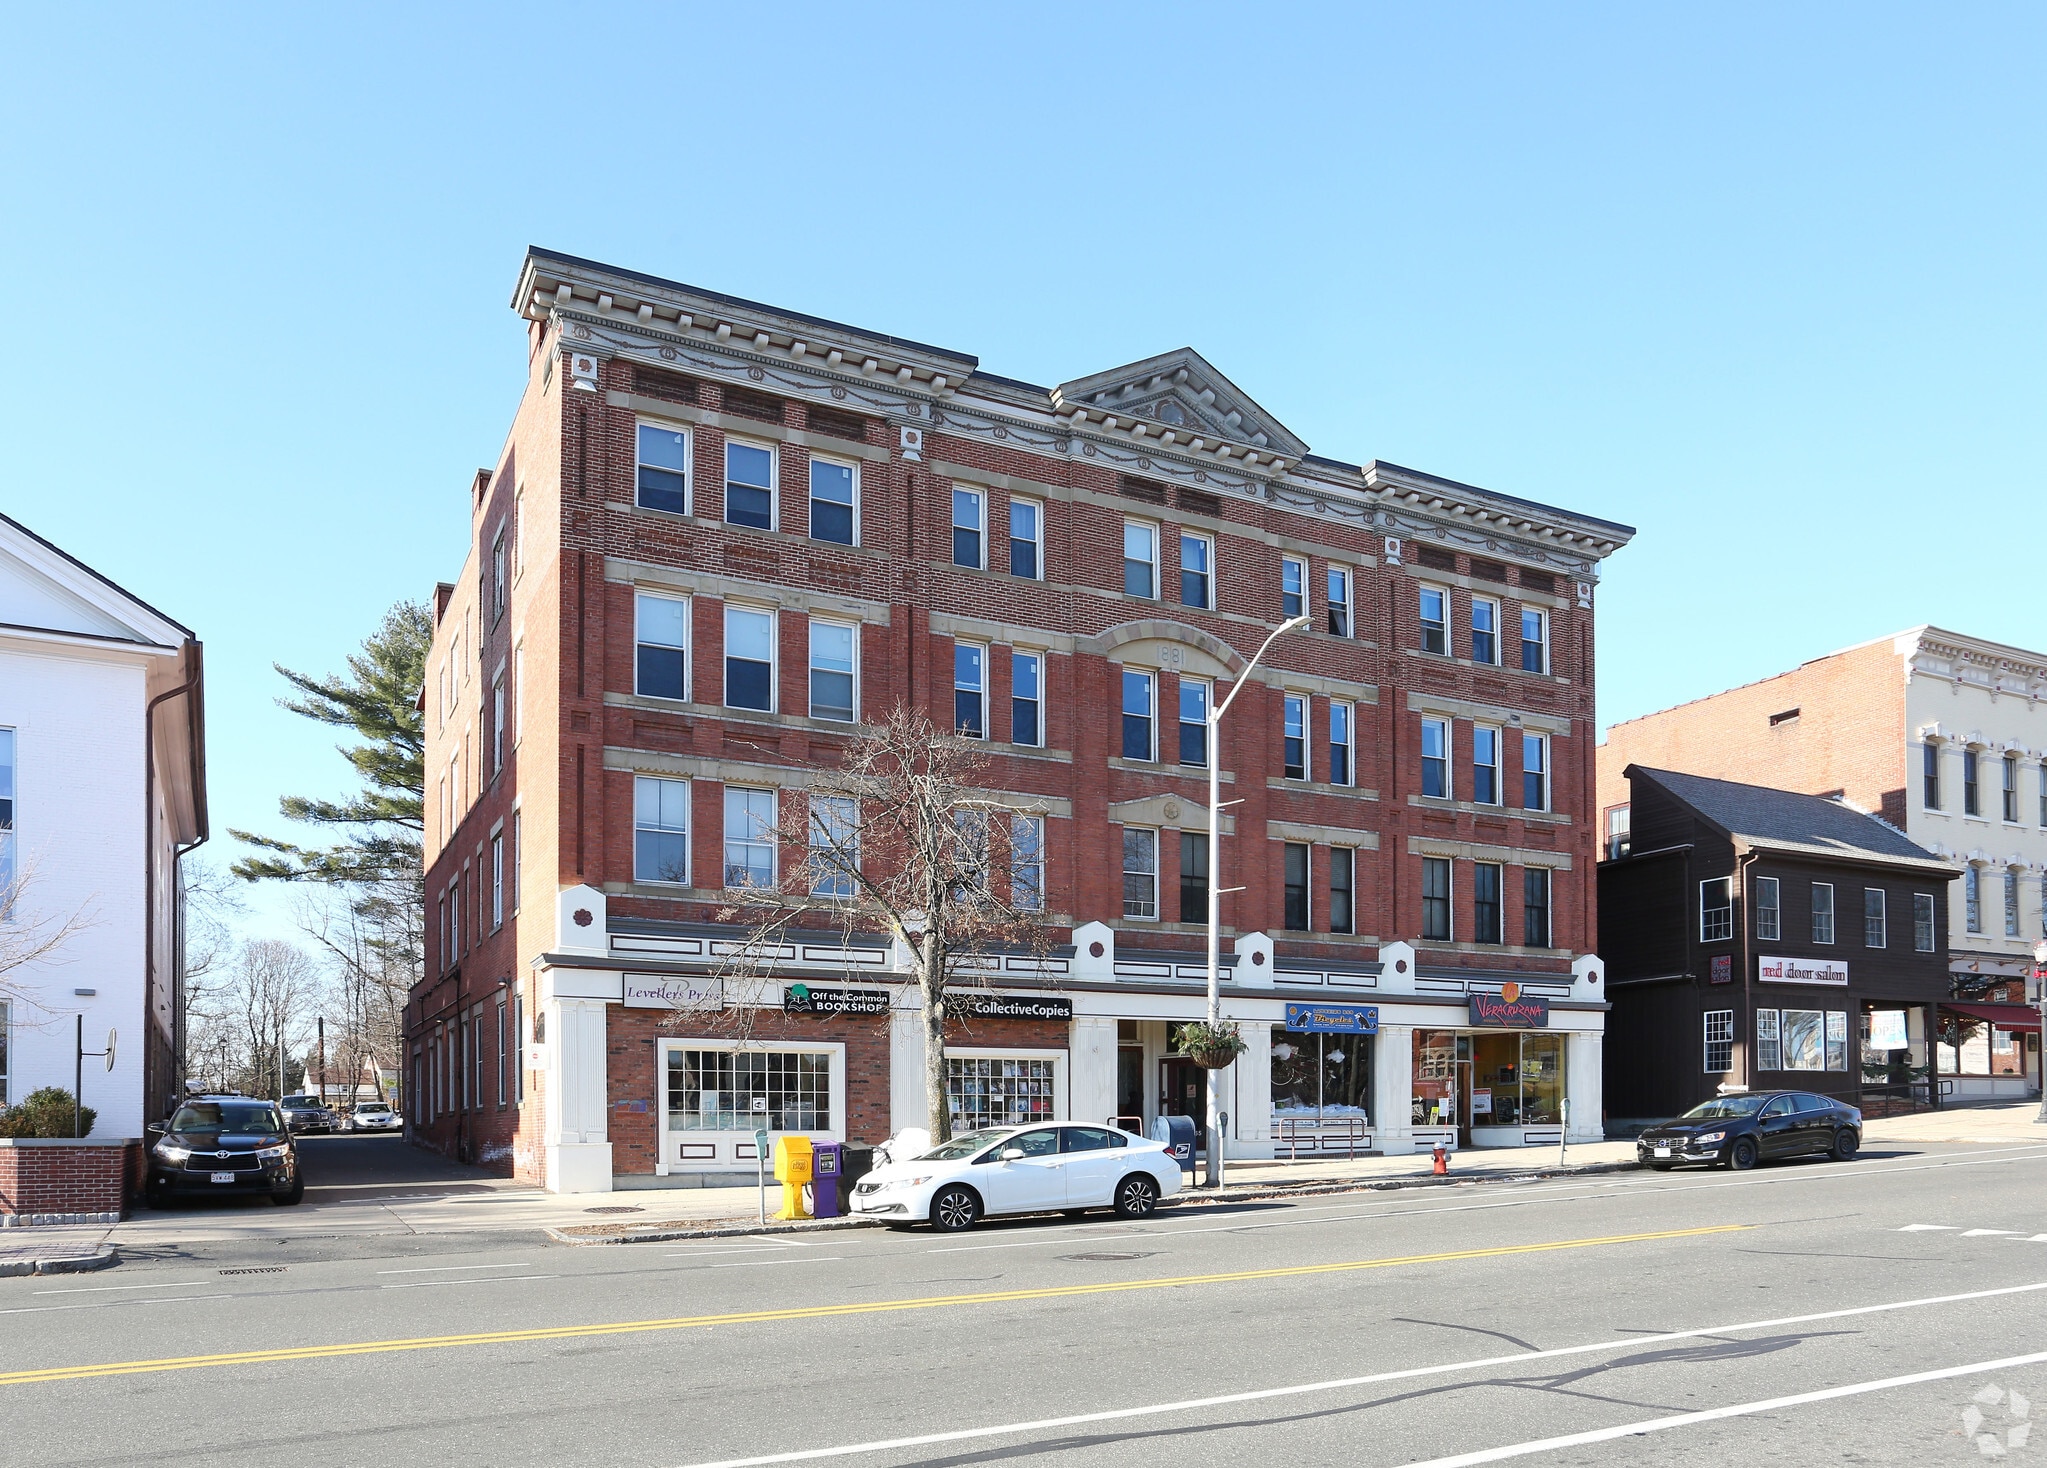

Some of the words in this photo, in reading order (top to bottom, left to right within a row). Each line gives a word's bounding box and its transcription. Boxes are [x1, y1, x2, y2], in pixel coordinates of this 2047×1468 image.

[1156, 645, 1184, 665] 1881
[1762, 962, 1783, 978] red
[1785, 963, 1814, 979] door
[1815, 965, 1846, 981] salon
[627, 986, 685, 1000] Levellers
[811, 991, 828, 1001] Off
[829, 992, 845, 1001] the
[846, 993, 888, 1003] Common
[816, 1001, 883, 1012] BOOKSHOP
[975, 1001, 1070, 1018] CollectiveCopies
[1476, 990, 1545, 1028] VERACRUZANA
